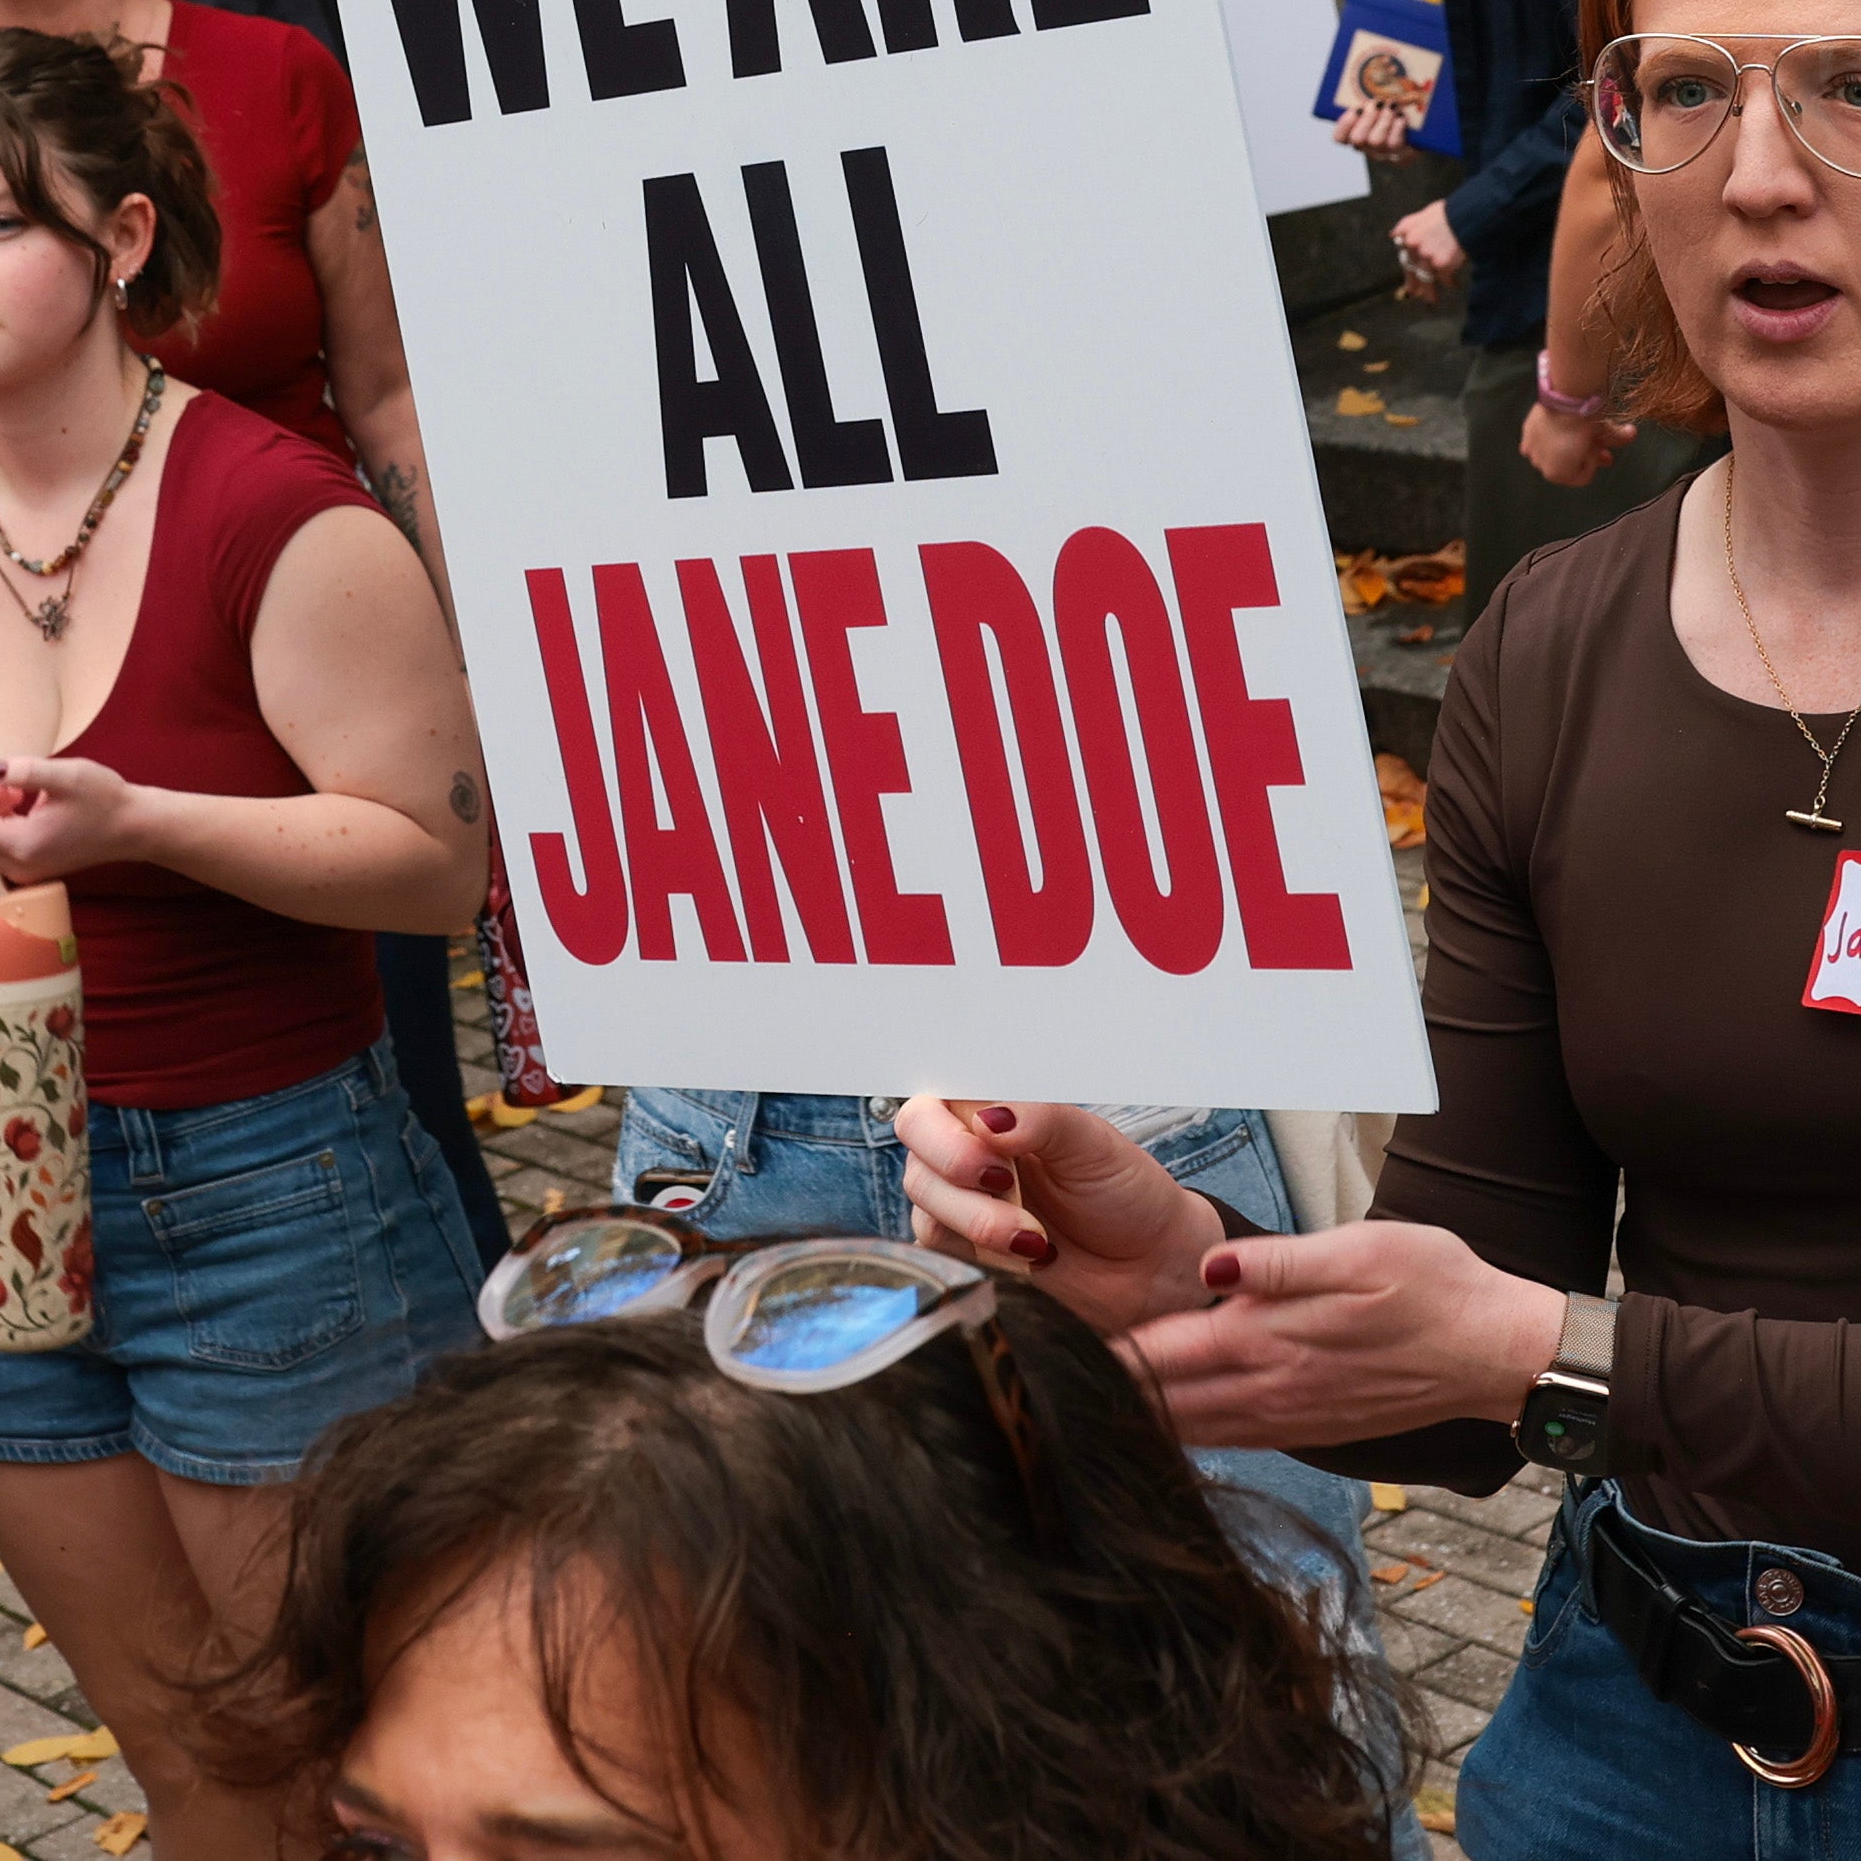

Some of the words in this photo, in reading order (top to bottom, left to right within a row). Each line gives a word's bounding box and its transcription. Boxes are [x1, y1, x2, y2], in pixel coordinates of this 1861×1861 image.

[643, 145, 998, 499] ALL
[523, 547, 955, 967] JANE
[917, 521, 1354, 976] DOE
